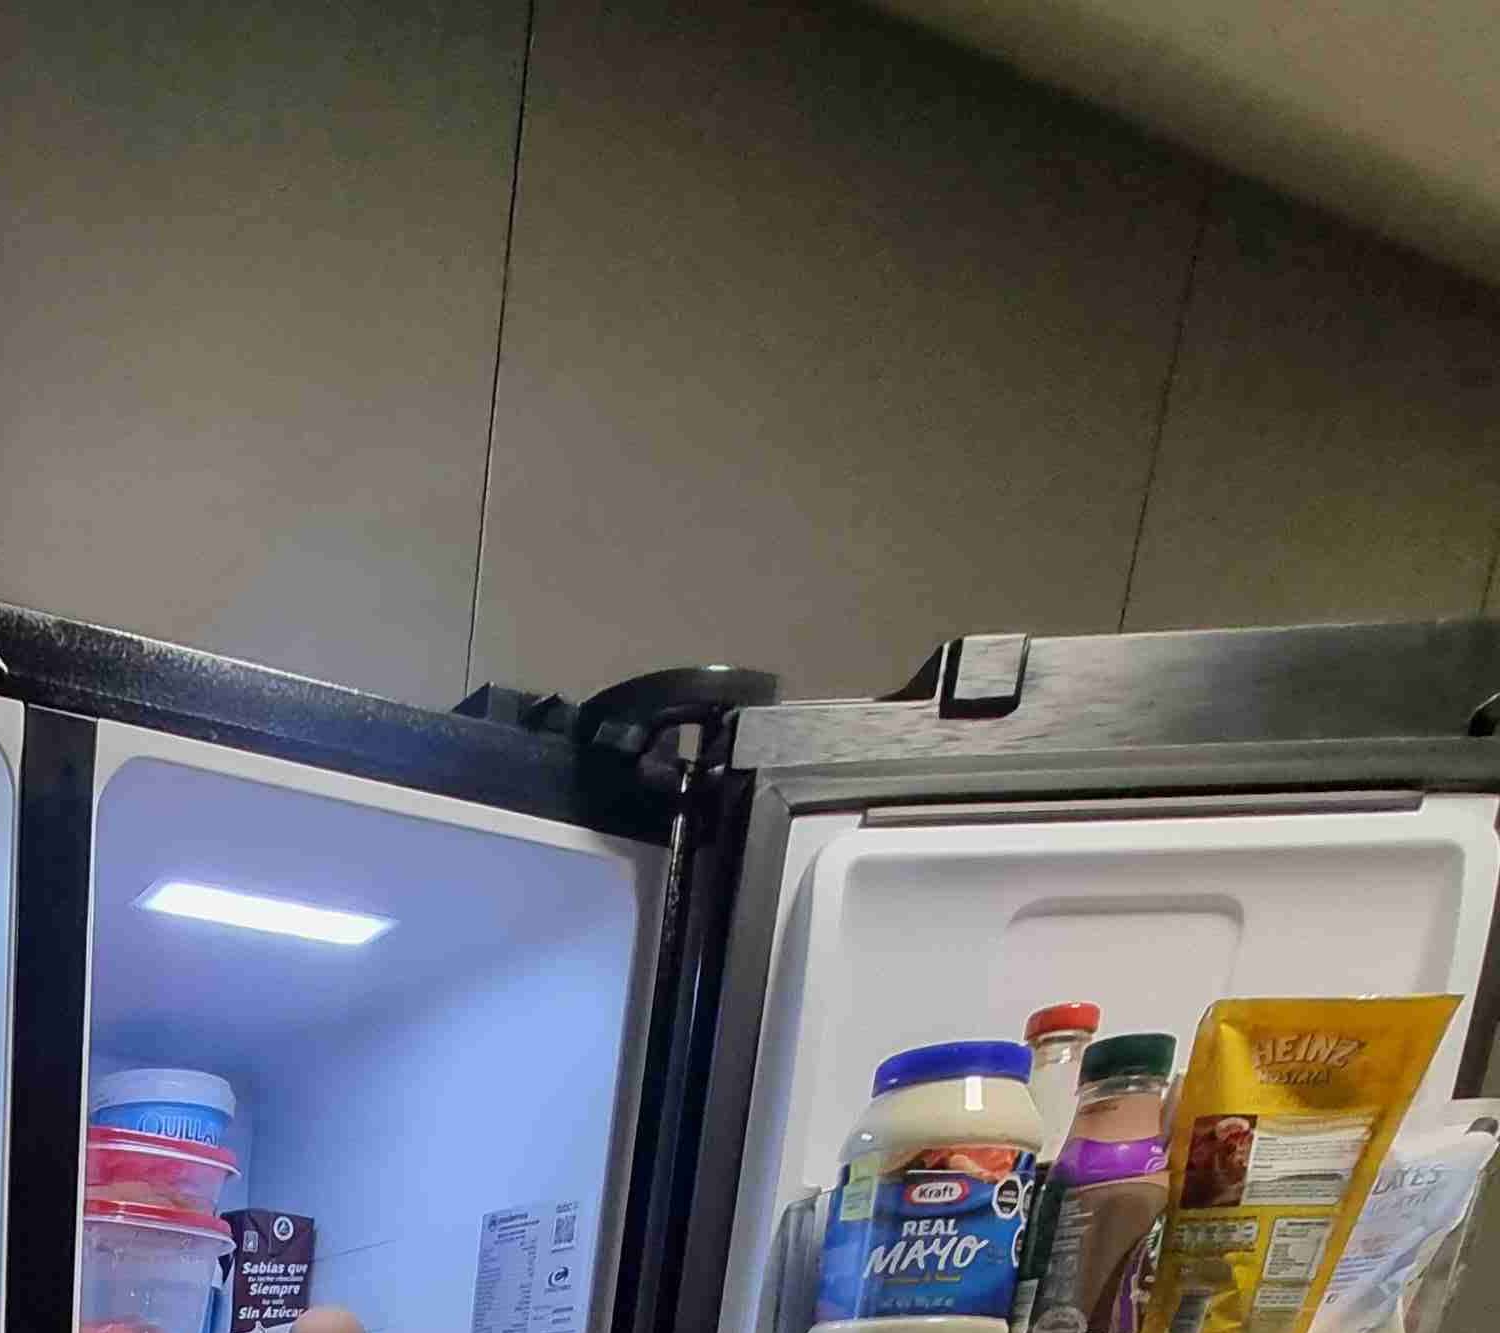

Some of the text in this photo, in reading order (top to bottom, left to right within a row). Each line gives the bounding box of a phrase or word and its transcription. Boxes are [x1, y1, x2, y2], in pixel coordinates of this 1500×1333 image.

[1253, 1033, 1366, 1069] HEINZ
[918, 1185, 955, 1199] Kraft
[902, 1218, 958, 1237] REAL
[862, 1235, 989, 1279] MAYO
[249, 1283, 300, 1298] Siempre
[238, 1306, 260, 1319] Sin
